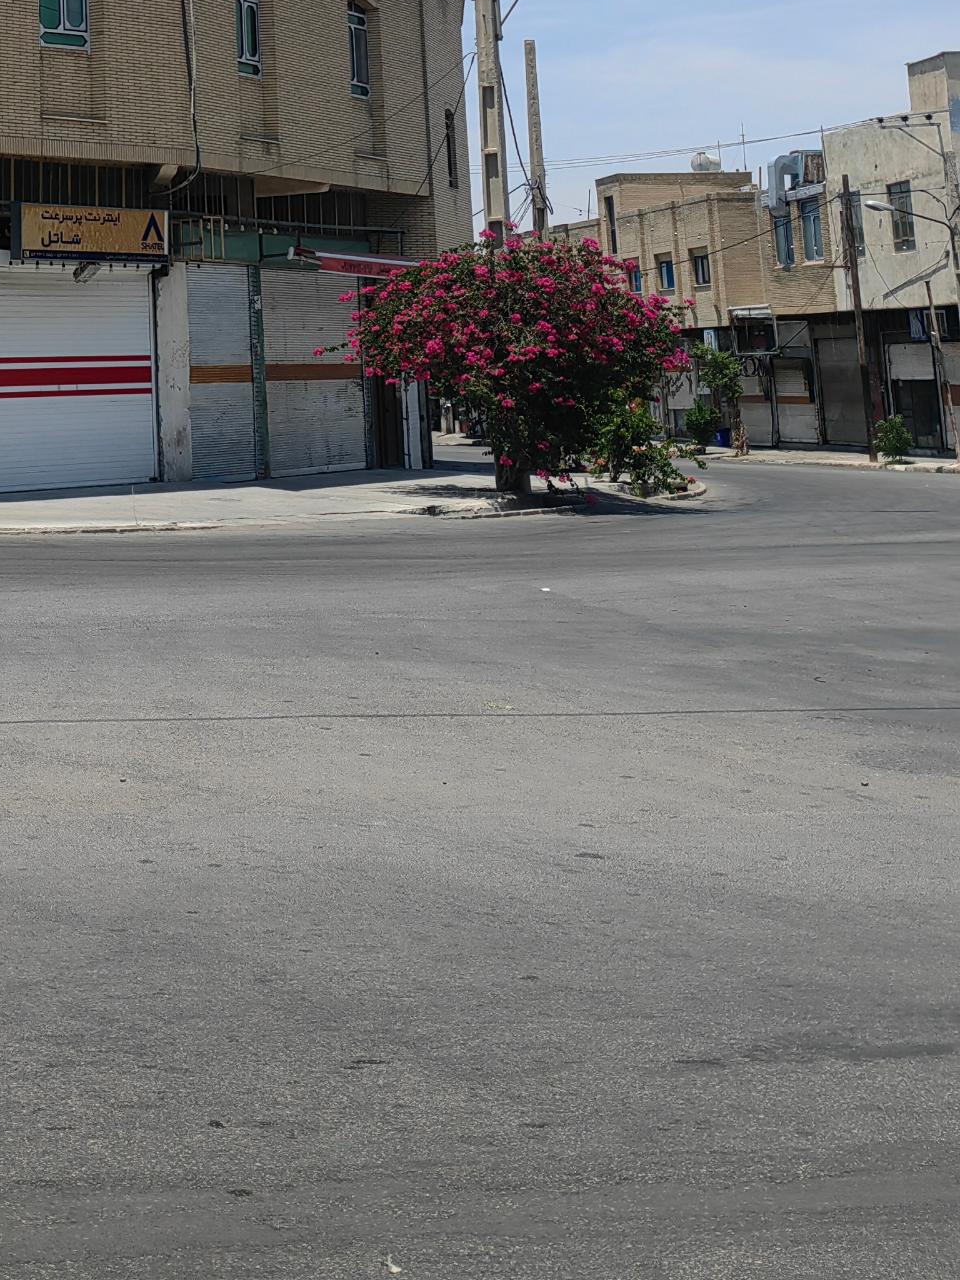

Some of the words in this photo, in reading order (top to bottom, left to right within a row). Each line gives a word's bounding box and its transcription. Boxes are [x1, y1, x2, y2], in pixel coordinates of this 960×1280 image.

[41, 210, 83, 225] پرسرعت
[85, 212, 121, 226] اینترنت
[41, 230, 81, 248] شاتل
[140, 241, 164, 251] SHATEL
